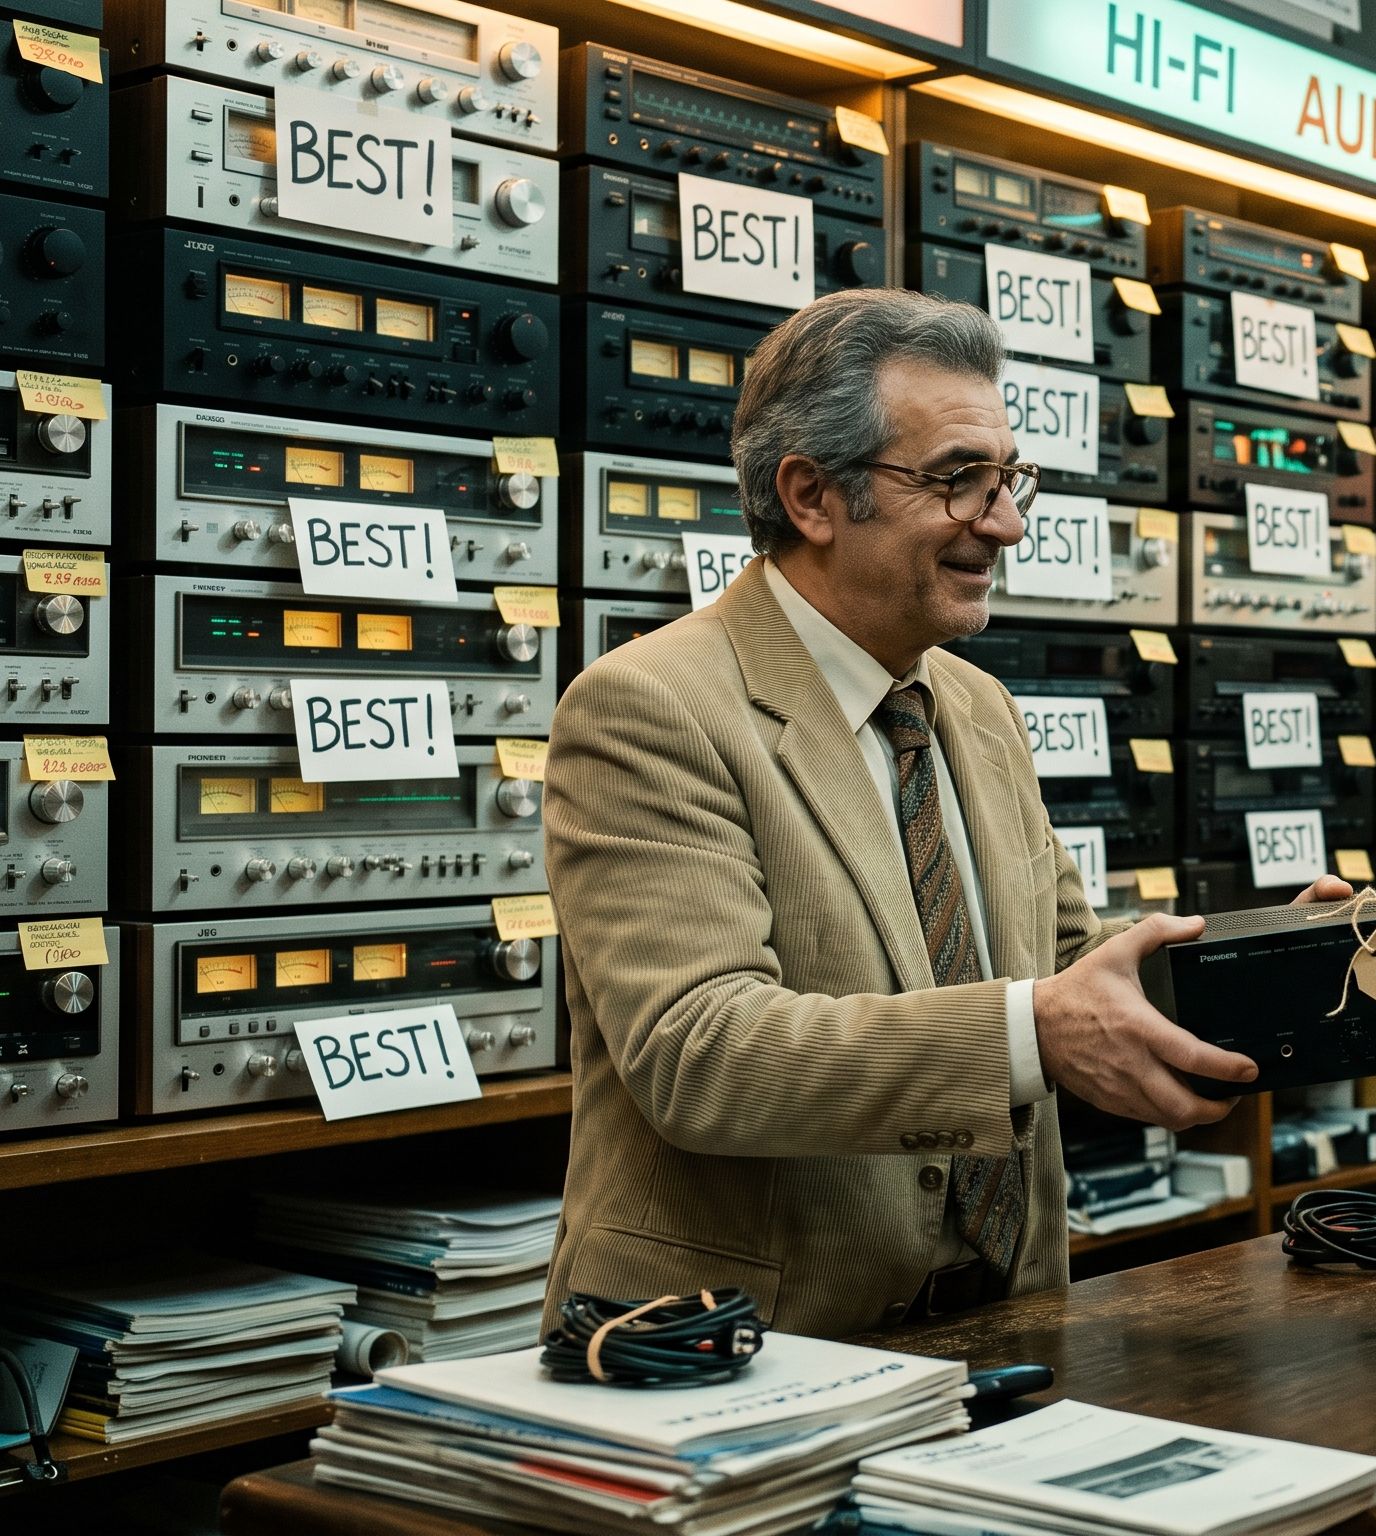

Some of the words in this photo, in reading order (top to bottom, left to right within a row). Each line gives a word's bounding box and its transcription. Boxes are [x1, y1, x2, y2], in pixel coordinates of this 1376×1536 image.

[1106, 2, 1236, 114] HI-FI
[290, 120, 434, 216] BEST!
[692, 204, 800, 281] BEST!
[997, 270, 1082, 339] BEST!
[1239, 315, 1309, 379] BEST!
[1003, 382, 1089, 451] BEST!
[307, 518, 434, 579] BEST!
[1017, 514, 1100, 575] BEST!
[1254, 502, 1321, 559] BEST!
[697, 549, 751, 593] BE
[306, 693, 435, 757] BEST!
[1024, 710, 1100, 758] BEST!
[1250, 705, 1313, 750] BEST!
[1255, 823, 1318, 867] BEST!
[312, 1020, 455, 1091] BEST!
